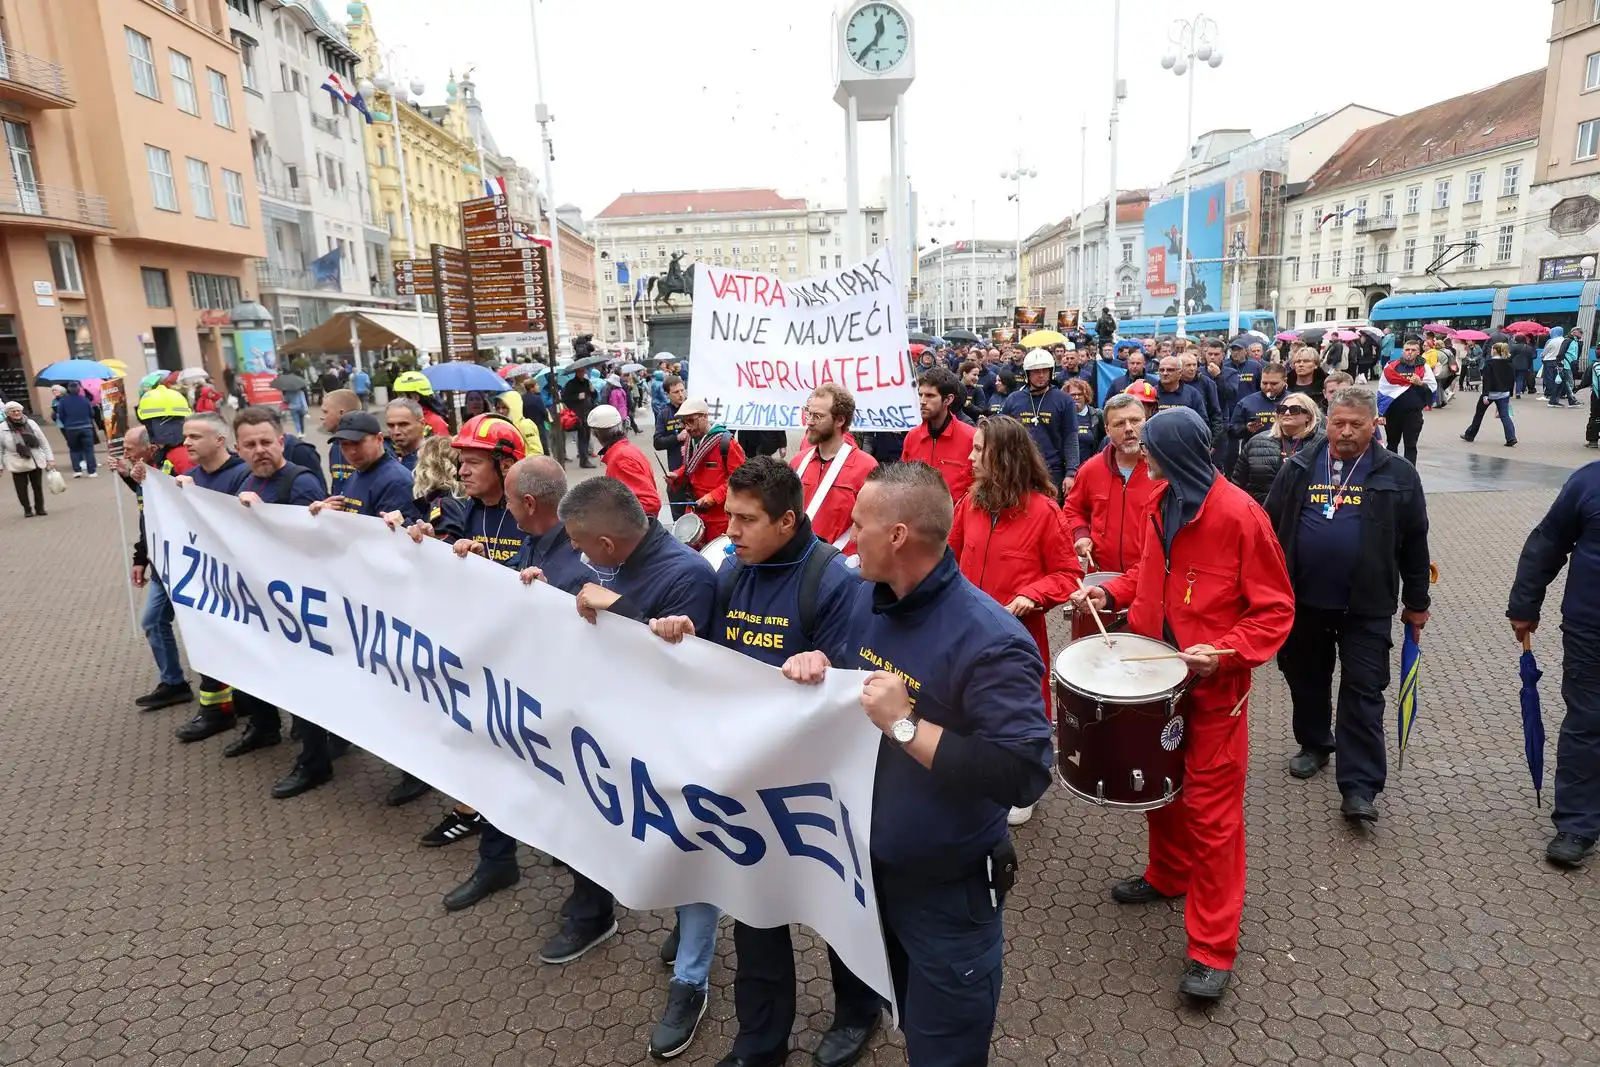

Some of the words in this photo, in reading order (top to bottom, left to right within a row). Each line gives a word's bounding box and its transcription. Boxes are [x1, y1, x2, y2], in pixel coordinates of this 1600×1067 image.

[707, 270, 786, 308] VATRA
[788, 280, 841, 307] NAM
[836, 258, 892, 296] IPAK
[710, 310, 771, 345] NIJE
[784, 300, 892, 345] NAJVEĆI
[736, 350, 917, 392] NEPRIJATELJ!
[1311, 494, 1329, 503] NE
[499, 538, 522, 546] VATRE
[742, 630, 784, 649] GASE
[267, 580, 334, 656] SE
[343, 596, 473, 733] VATRE
[483, 666, 565, 786] NE
[571, 726, 866, 908] GASE!
